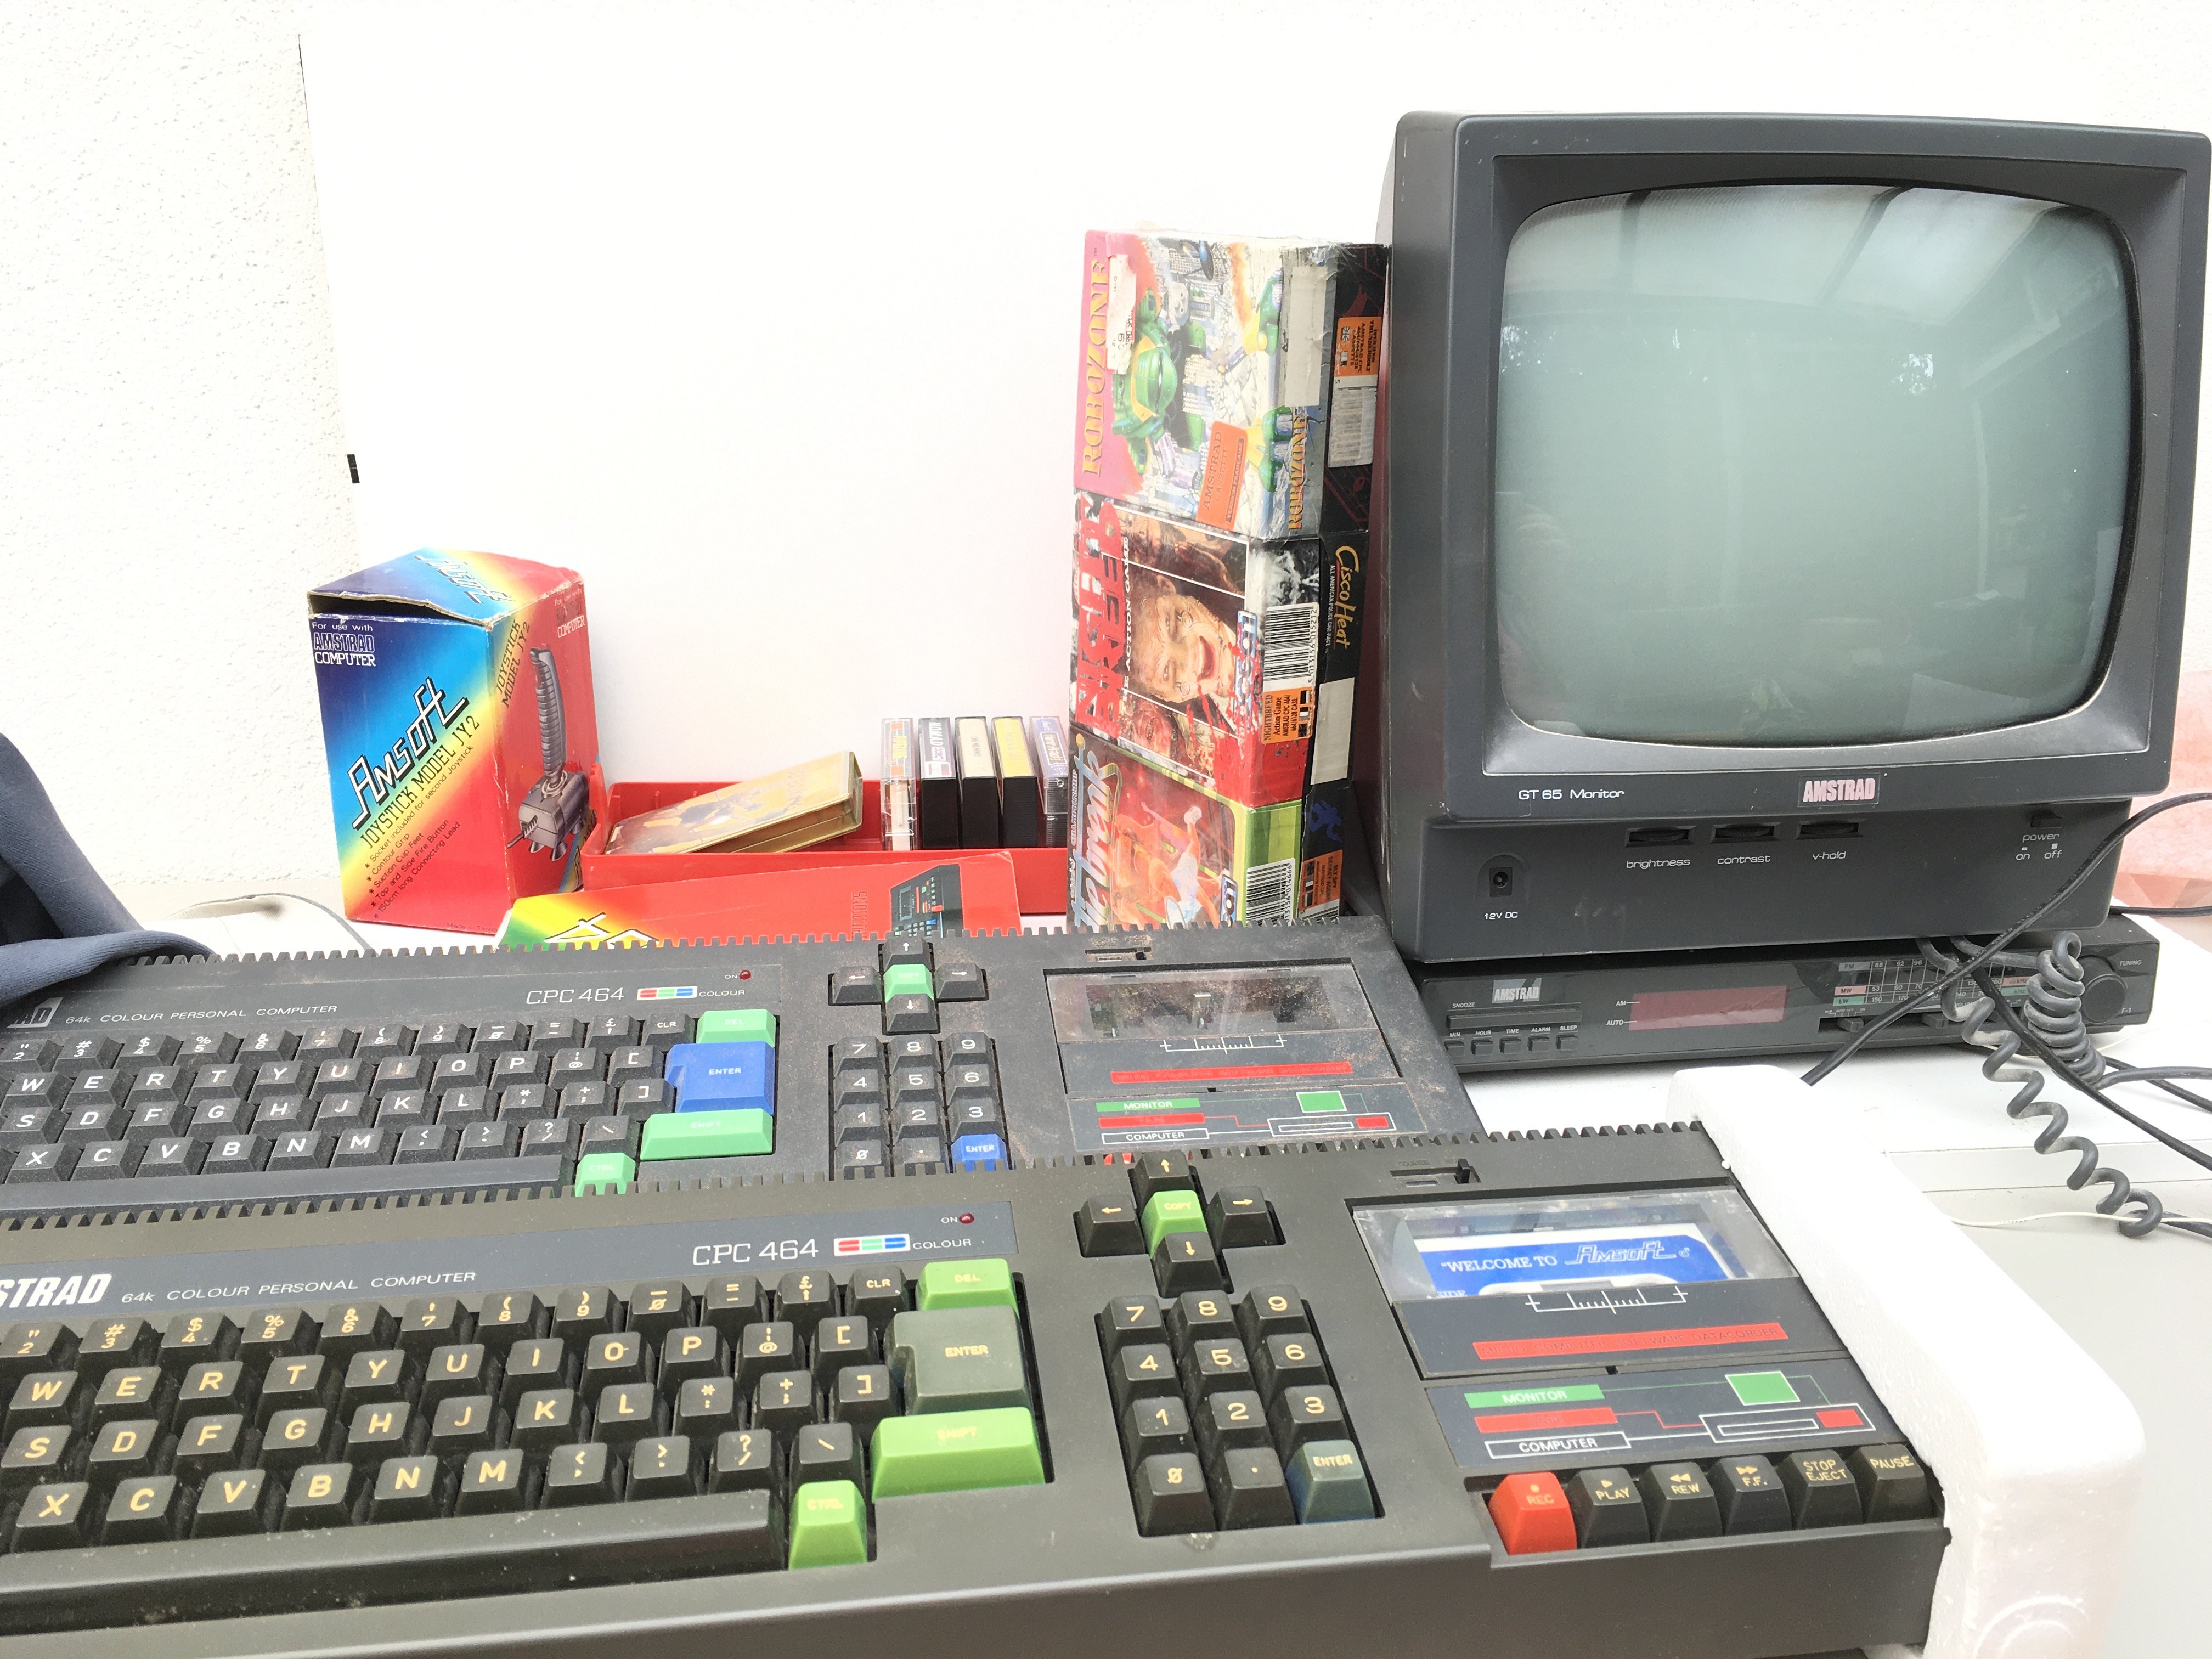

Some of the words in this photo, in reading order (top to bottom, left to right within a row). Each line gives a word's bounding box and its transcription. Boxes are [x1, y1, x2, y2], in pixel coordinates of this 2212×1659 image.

[1084, 258, 1109, 477] ROBOZONE
[1203, 431, 1222, 510] AMSTRAD
[1214, 447, 1228, 501] CASSETTE
[1288, 415, 1309, 531] ROBOZONE
[1227, 486, 1237, 518] VERSION
[1121, 535, 1130, 593] GAME
[1335, 545, 1360, 601] Cisco
[311, 622, 329, 631] For
[331, 623, 348, 631] use
[351, 622, 374, 633] with
[557, 615, 585, 639] COMPUTER
[1333, 601, 1357, 650] Heat
[313, 633, 375, 653] AMSTRAD
[314, 652, 376, 667] COMPUTER
[494, 618, 522, 693] JOYSTICK
[501, 657, 521, 708] MODEL
[1273, 697, 1282, 715] Game
[1263, 695, 1273, 741] NIGHTBREED
[359, 786, 419, 849] JOYSTICK
[415, 743, 457, 794] MODEL
[1518, 789, 1539, 800] GT
[1542, 789, 1562, 800] 65
[1569, 788, 1624, 800] Monitor
[1803, 777, 1875, 803] AMSTRAD
[370, 838, 392, 863] Socket
[390, 810, 416, 840] included
[414, 799, 426, 812] for
[424, 774, 448, 800] second
[445, 743, 474, 776] Joystick
[2022, 832, 2060, 844] power
[371, 848, 397, 876] Contour
[394, 832, 411, 849] Grip
[374, 862, 397, 889] Suction
[395, 848, 410, 864] Cup
[408, 832, 424, 849] Feet
[375, 885, 391, 902] Top
[388, 872, 402, 887] and
[400, 856, 416, 873] Side
[414, 842, 429, 857] Fire
[427, 818, 449, 843] Button
[397, 874, 414, 892] long
[411, 838, 446, 877] Connecting
[443, 821, 461, 840] Lead
[1717, 855, 1771, 865] contrast
[1812, 851, 1847, 861] v-hold
[2016, 852, 2030, 861] on
[2044, 849, 2062, 859] off
[1626, 858, 1691, 870] brightness
[1483, 911, 1503, 920] 12V
[1505, 911, 1519, 919] DC
[526, 989, 575, 1005] CPC
[578, 987, 625, 1002] 464
[698, 989, 746, 997] COLOUR
[1493, 986, 1539, 1002] AMSTRAD
[65, 1015, 91, 1025] 64k
[99, 1012, 165, 1023] COLOUR
[170, 1009, 247, 1020] PERSONAL
[256, 1005, 338, 1017] COMPUTER
[708, 1066, 742, 1075] ENTER
[1123, 1099, 1174, 1110] MONITOR
[1125, 1130, 1185, 1141] COMPUTER
[966, 1144, 995, 1153] ENTER
[1164, 1200, 1192, 1211] COPY
[941, 1215, 958, 1224] ON
[692, 1242, 752, 1266] CPC
[758, 1238, 820, 1262] 464
[912, 1238, 972, 1251] COLOUR
[1536, 1256, 1558, 1266] TO
[866, 1278, 891, 1289] CLR
[953, 1273, 981, 1283] DEL
[121, 1292, 156, 1304] 64k
[167, 1286, 250, 1301] COLOUR
[258, 1279, 359, 1295] PERSONAL
[370, 1271, 477, 1289] COMPUTER
[1536, 1339, 1607, 1353] COMPUTER
[1616, 1332, 1685, 1347] SOFTWARE
[1692, 1327, 1780, 1343] DATACORDER
[944, 1345, 990, 1358] ENTER
[32, 1381, 62, 1401] W
[1502, 1389, 1568, 1404] MONITOR
[936, 1426, 978, 1440] SHIFT
[1519, 1437, 1598, 1453] COMPUTER
[1313, 1453, 1353, 1468] ENTER
[1803, 1459, 1837, 1474] STOP
[1869, 1454, 1916, 1470] PAUSE
[1742, 1476, 1768, 1488] F.F.
[1805, 1468, 1848, 1484] EJECT
[1595, 1486, 1630, 1502] PLAY
[1670, 1483, 1700, 1496] REW
[806, 1498, 843, 1510] CTRL
[1526, 1493, 1555, 1506] REC
